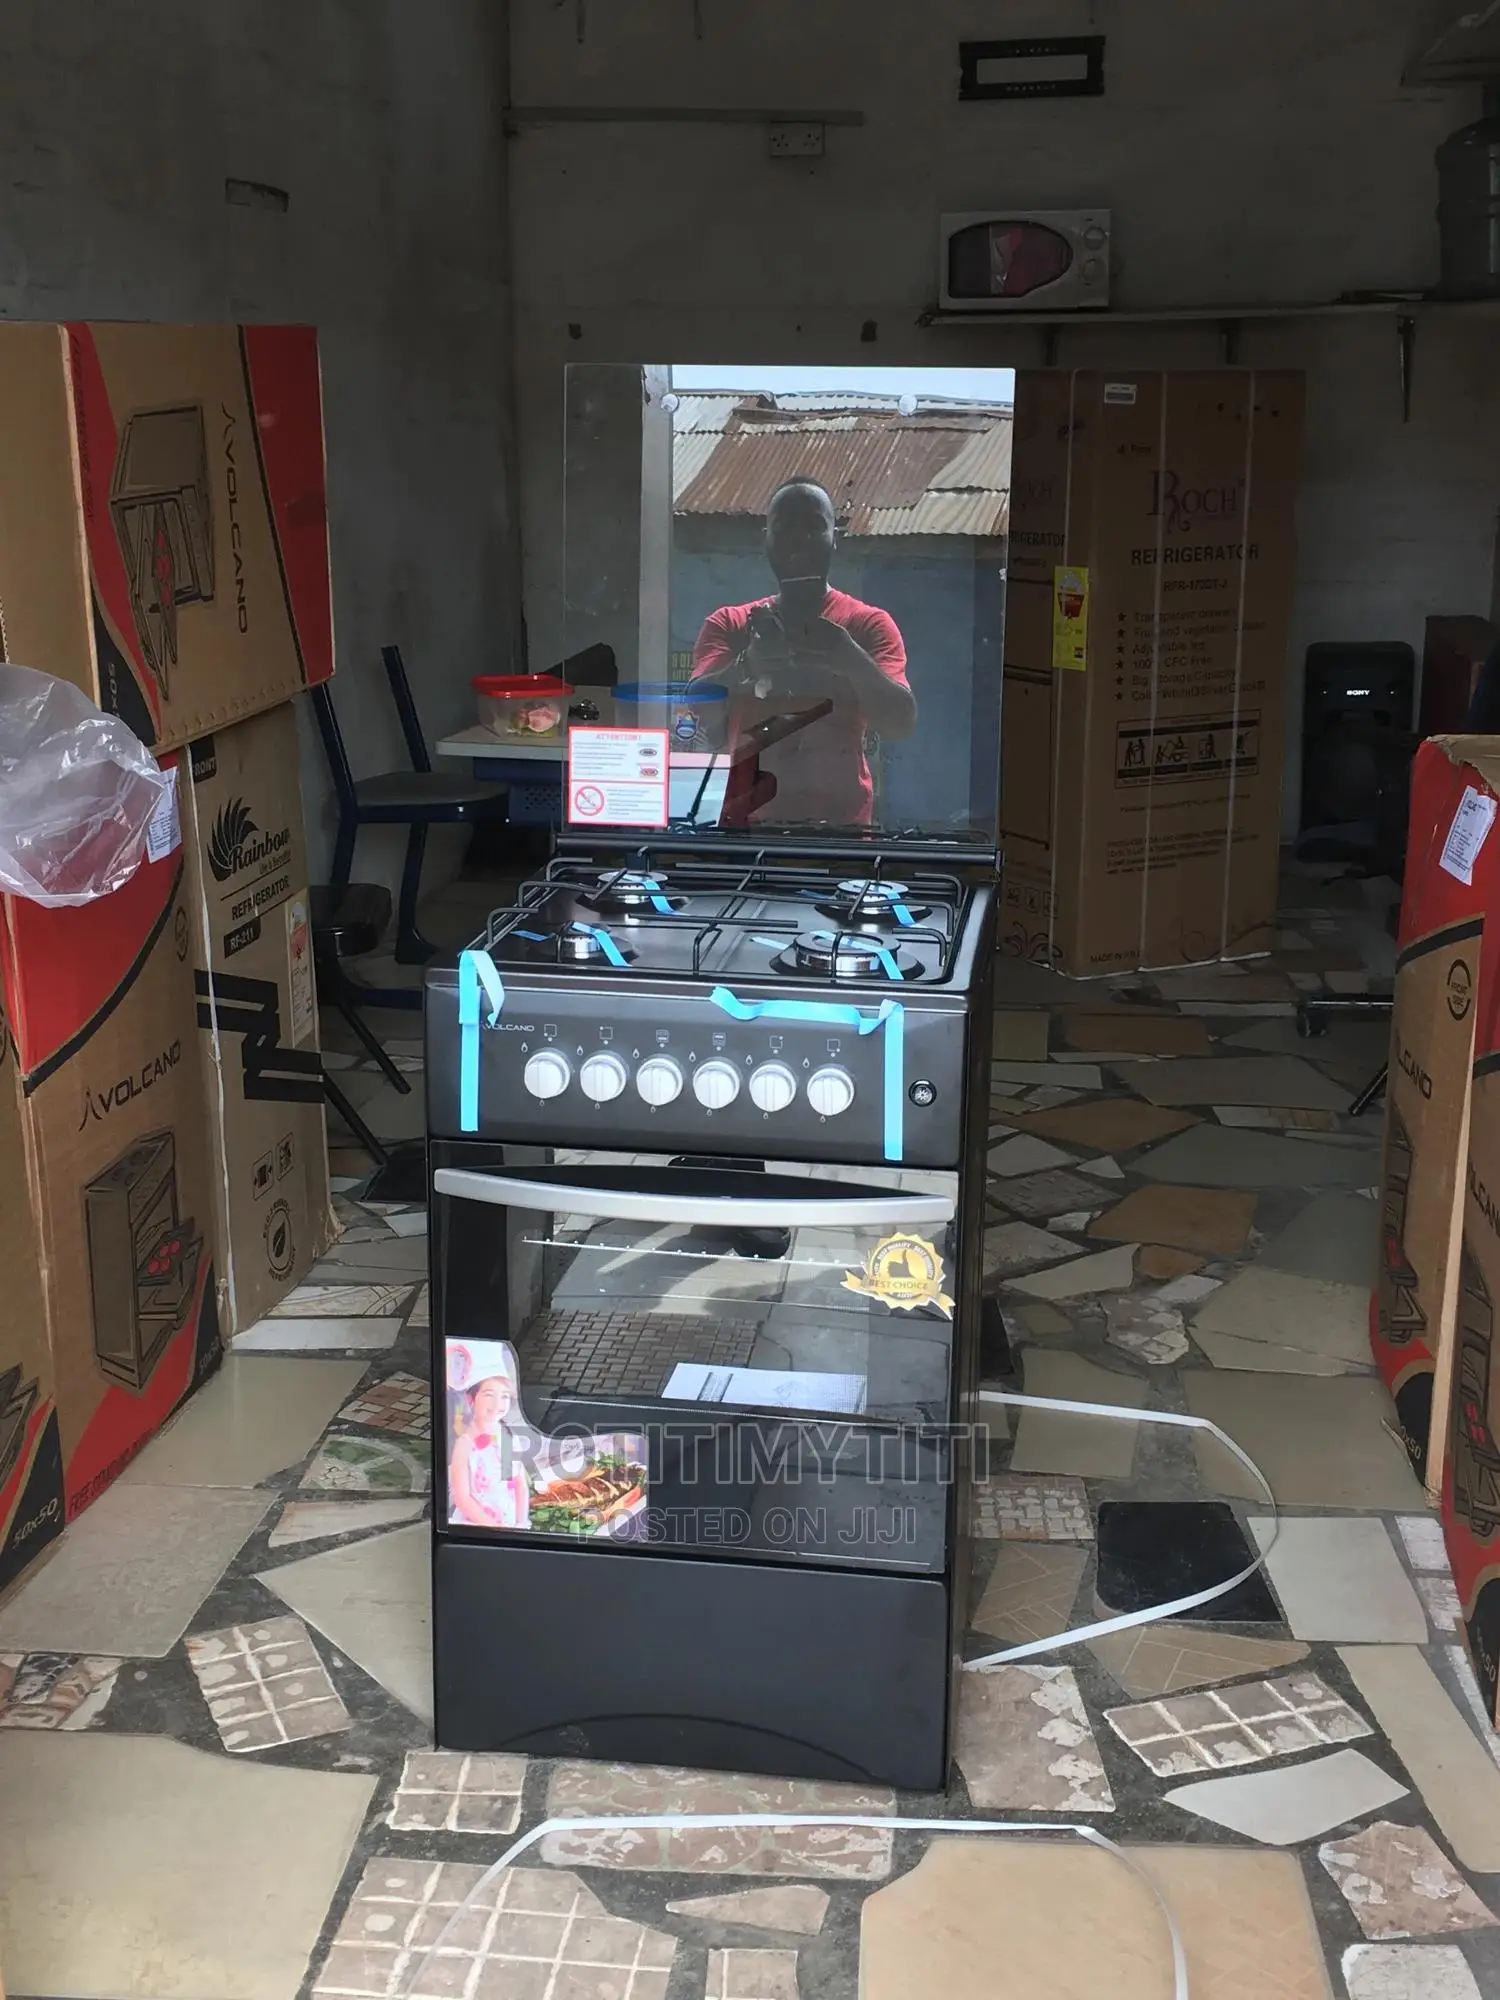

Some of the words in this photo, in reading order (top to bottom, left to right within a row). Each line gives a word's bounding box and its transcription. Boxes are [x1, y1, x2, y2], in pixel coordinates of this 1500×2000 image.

[226, 438, 249, 634] VOLCANO
[1131, 543, 1259, 566] RERIGERATOR
[1133, 657, 1158, 669] 100
[232, 875, 291, 921] REFRIGERATOR
[99, 1038, 181, 1113] VOLCANO
[868, 1278, 891, 1289] BEST
[892, 1278, 929, 1291] CHOICE
